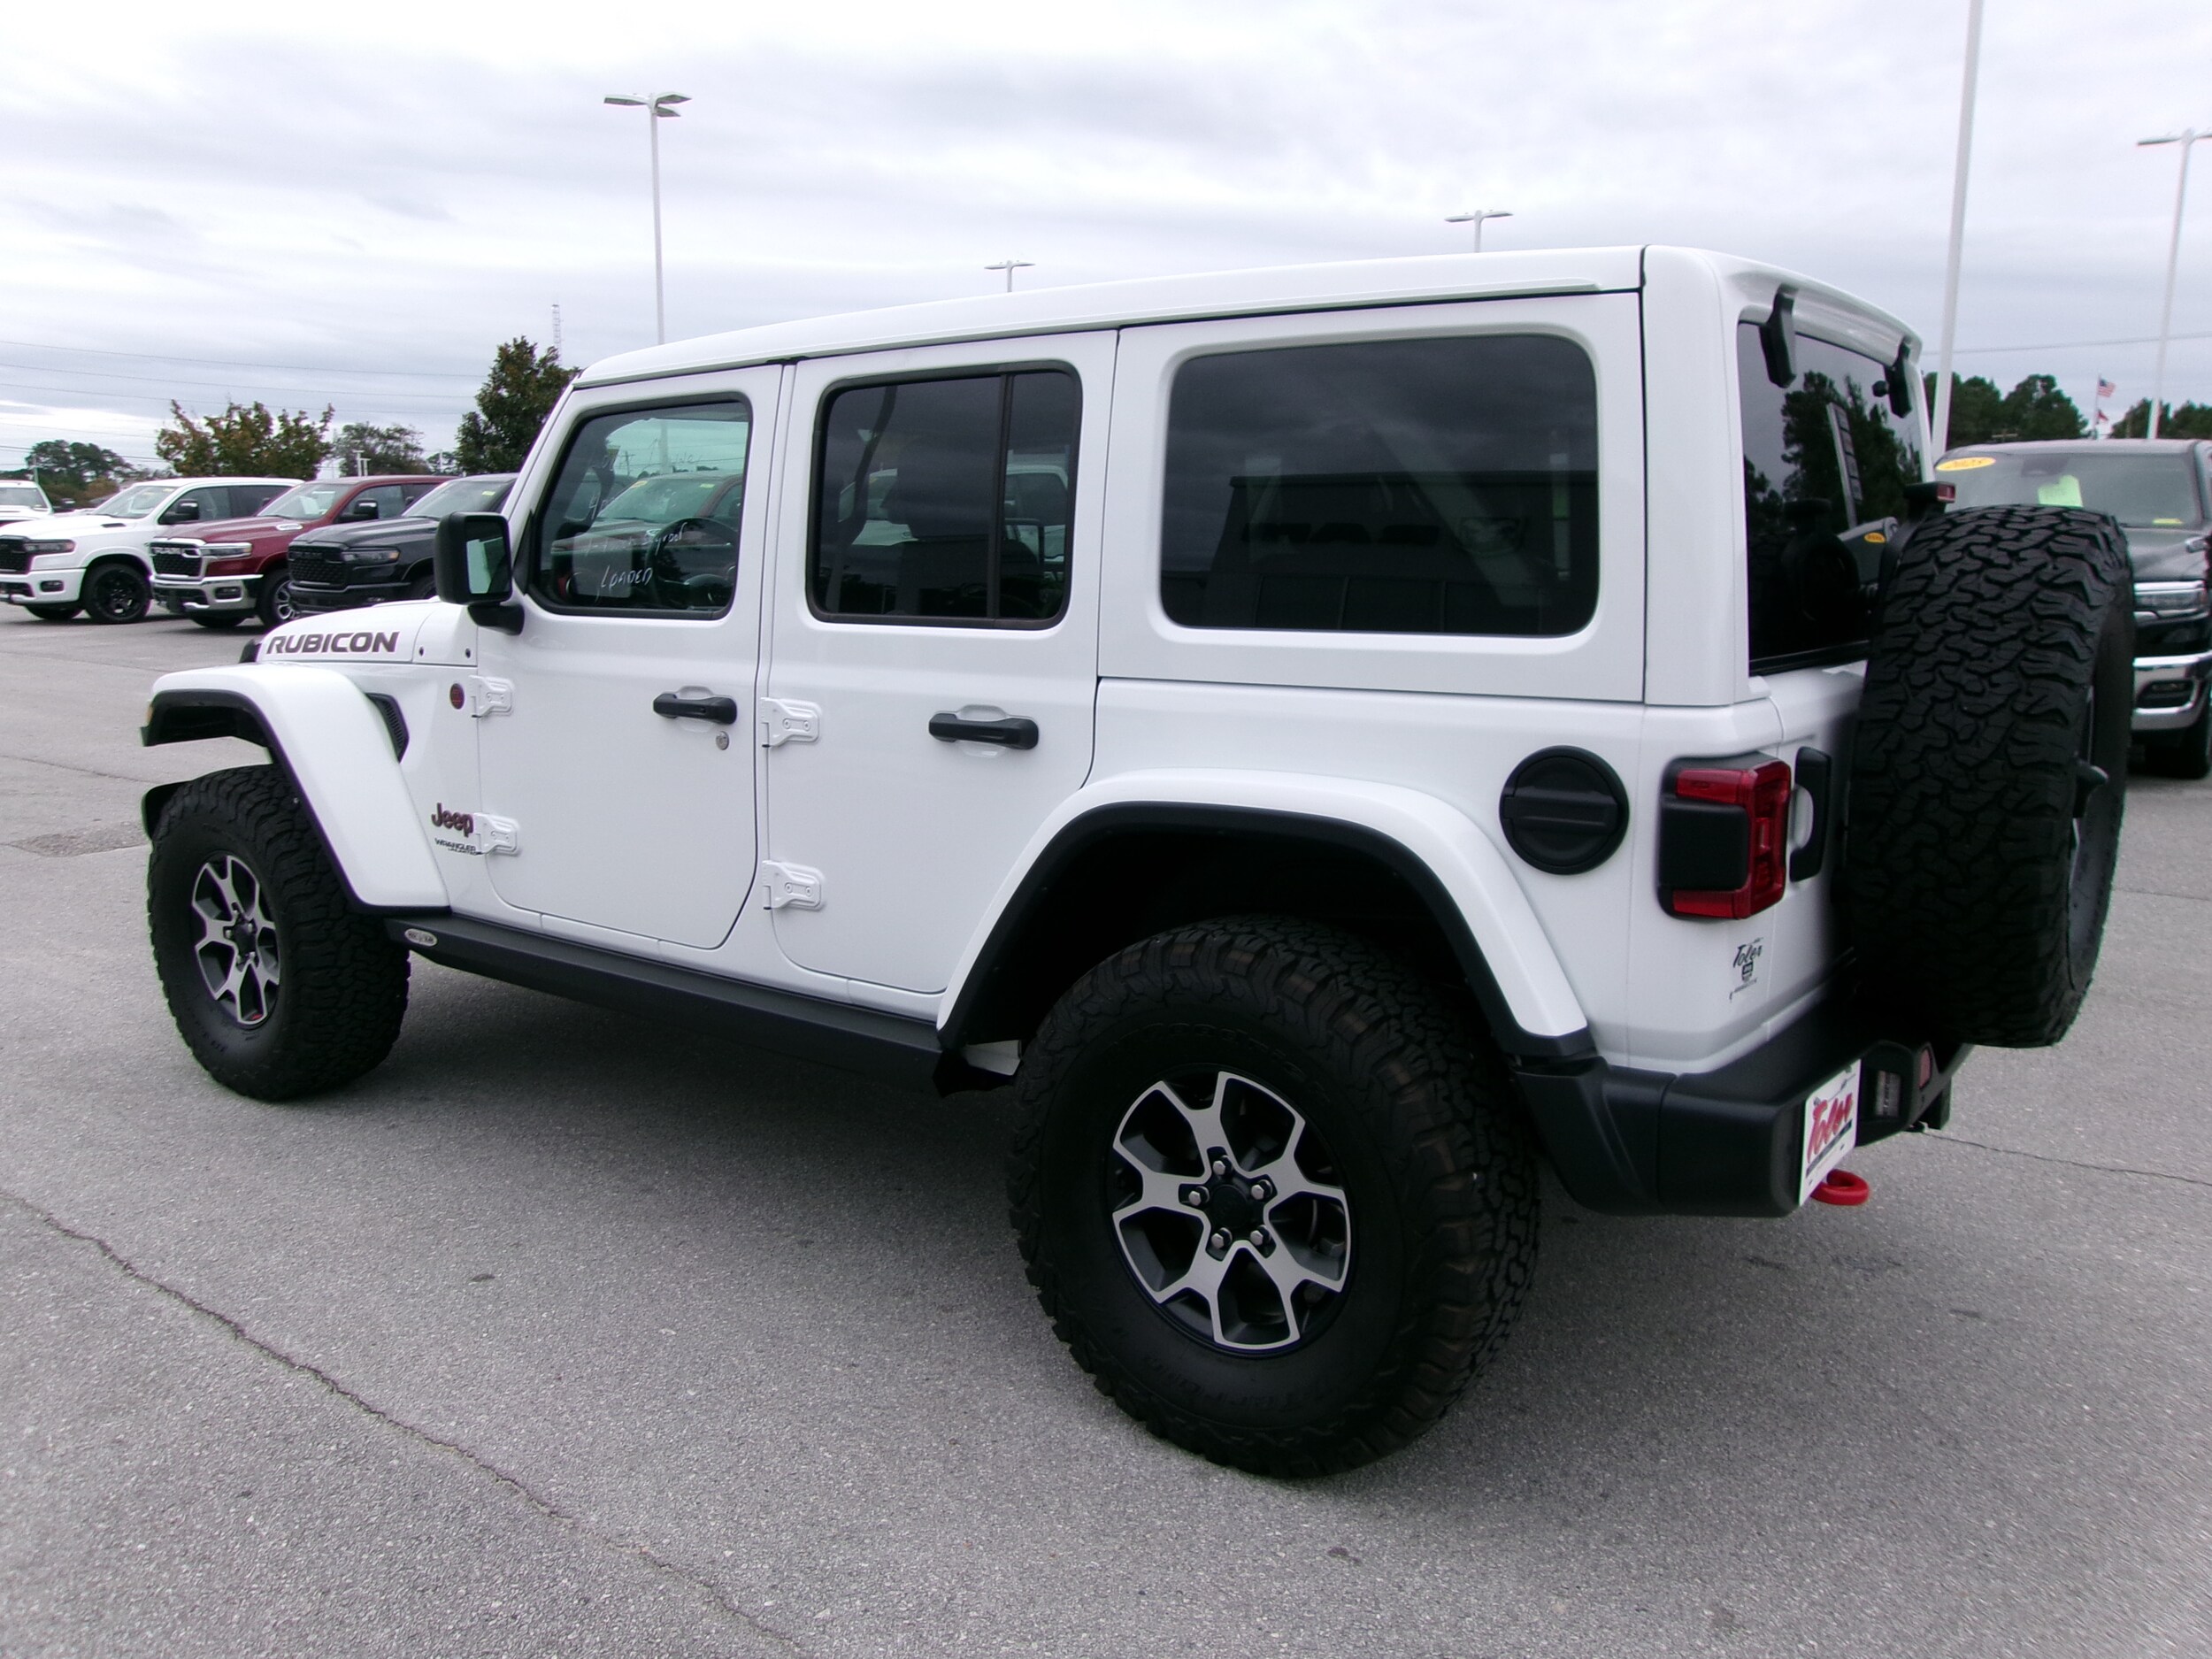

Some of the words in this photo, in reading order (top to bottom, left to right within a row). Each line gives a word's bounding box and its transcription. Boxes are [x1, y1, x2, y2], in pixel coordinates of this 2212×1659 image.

[266, 631, 400, 654] RUBICON
[431, 802, 474, 838] Jeep
[434, 837, 476, 851] WRANGLER
